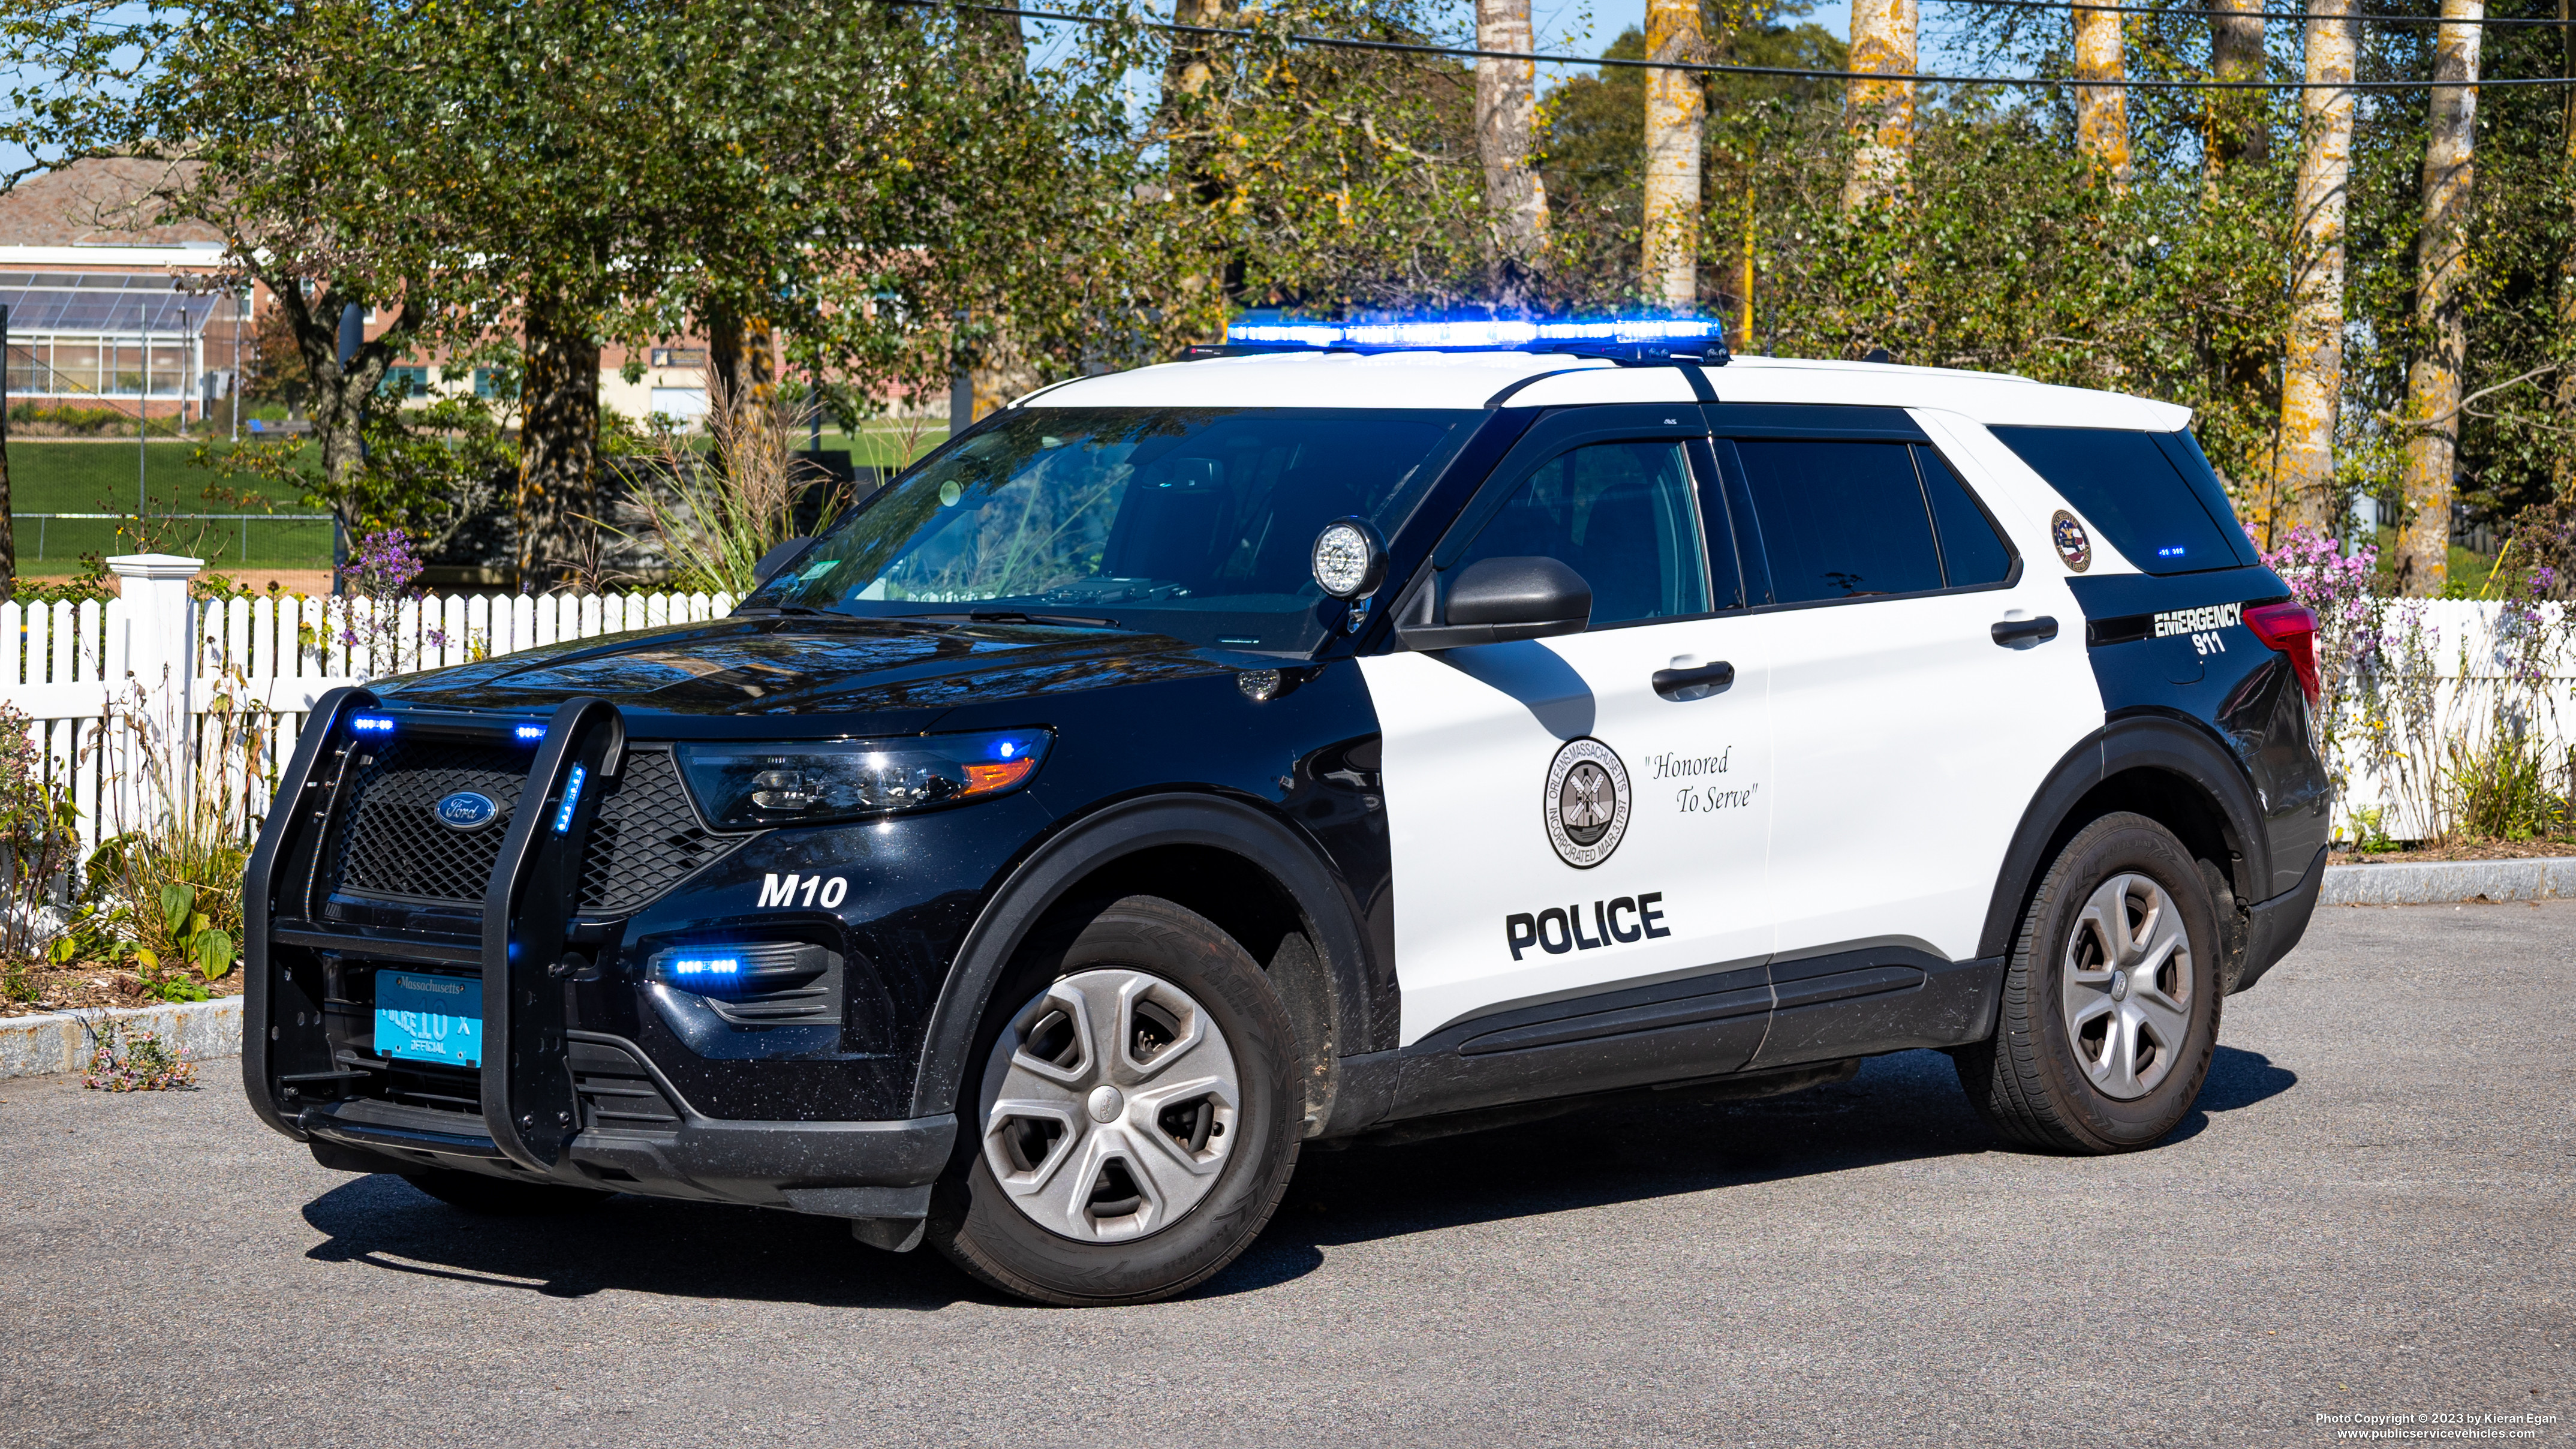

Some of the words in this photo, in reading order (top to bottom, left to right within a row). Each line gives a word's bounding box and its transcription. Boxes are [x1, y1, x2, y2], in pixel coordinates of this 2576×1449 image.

[2154, 602, 2241, 638] EMERGENCY
[2192, 631, 2225, 655] 911
[1645, 745, 1731, 780] "Honored
[446, 798, 479, 819] Ford
[1677, 786, 1698, 812] To
[1703, 783, 1758, 813] Serve"
[1549, 807, 1596, 862] INCORPORATED
[757, 873, 847, 909] M10
[1506, 891, 1672, 961] POLICE
[400, 976, 460, 994] Massachusetts
[382, 994, 417, 1038] POLICE
[410, 1039, 446, 1054] OFFICIAL
